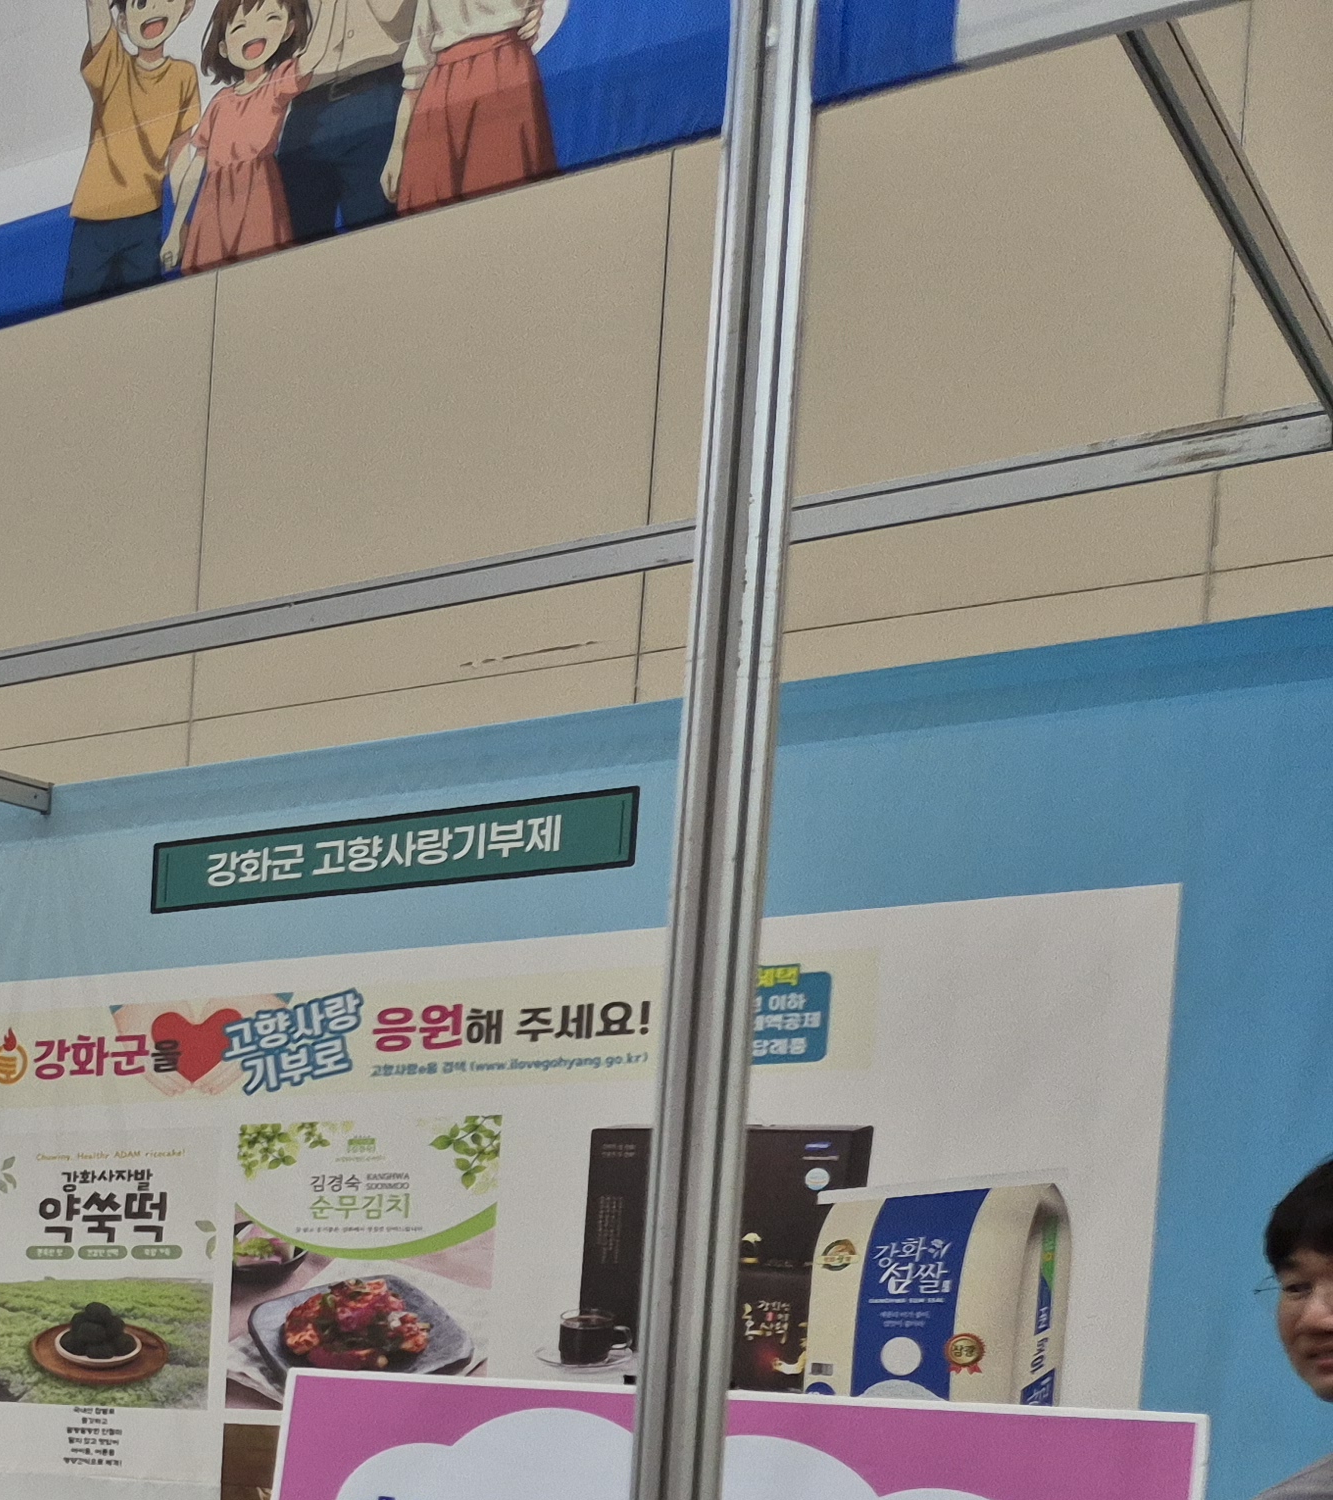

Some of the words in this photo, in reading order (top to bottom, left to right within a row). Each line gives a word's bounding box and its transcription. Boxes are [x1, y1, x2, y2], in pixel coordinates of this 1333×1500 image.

[206, 845, 304, 888] 강화군
[312, 813, 561, 878] 고향사랑기부제
[769, 992, 807, 1010] 이하
[33, 1034, 182, 1080] 강화군을
[221, 988, 364, 1062] 고향사랑
[372, 1003, 504, 1052] 응원해
[515, 1000, 651, 1042] 주세요!
[242, 1034, 352, 1097] 기부로
[61, 1169, 153, 1192] 강화사자발
[310, 1174, 362, 1193] 김경숙
[38, 1191, 168, 1243] 약쑥떡
[309, 1193, 410, 1220] 순무김치
[873, 1236, 928, 1269] 강화
